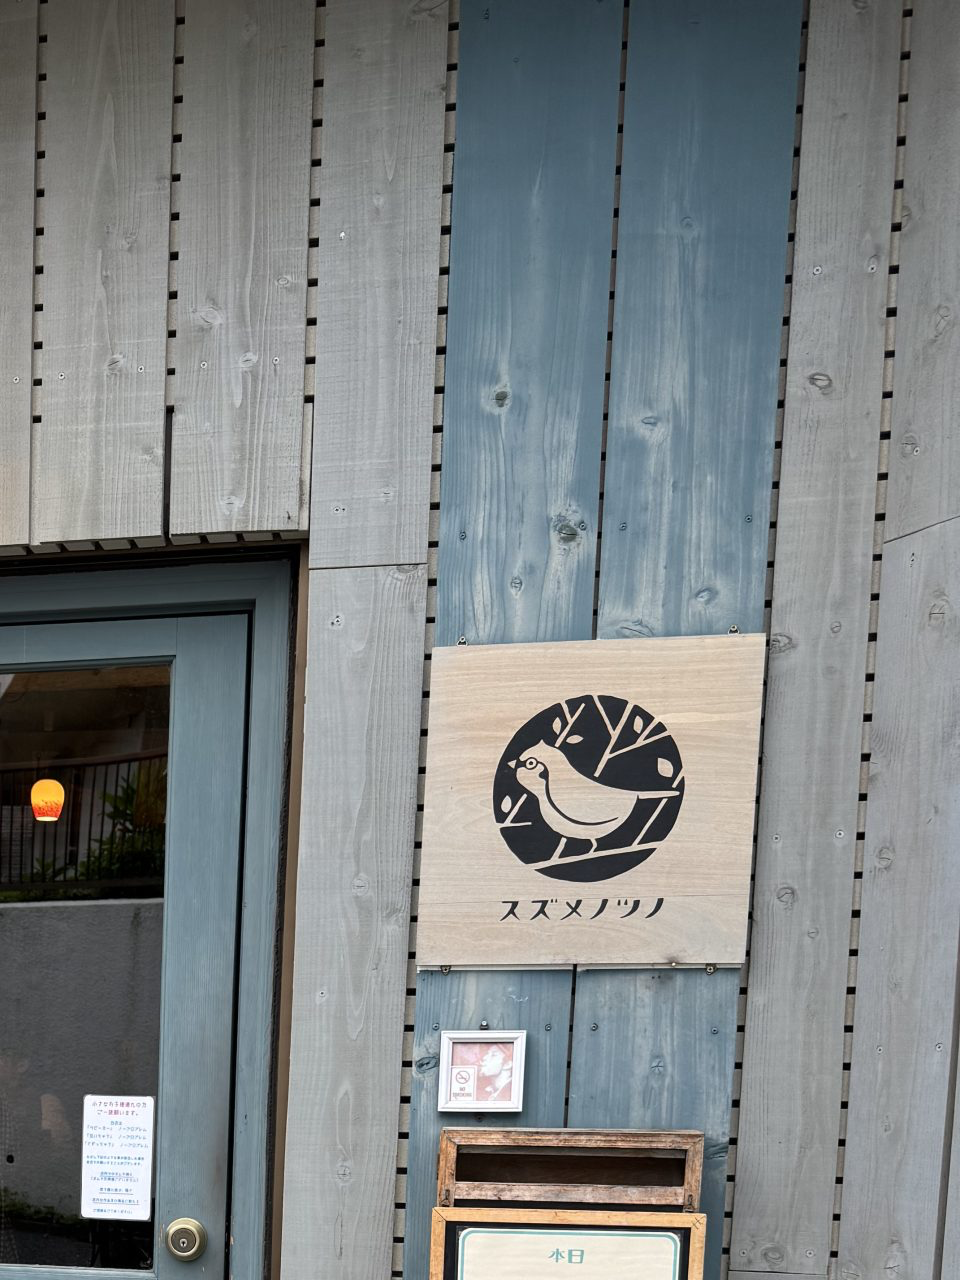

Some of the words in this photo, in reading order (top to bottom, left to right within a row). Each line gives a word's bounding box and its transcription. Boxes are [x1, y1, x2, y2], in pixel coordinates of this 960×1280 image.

[499, 897, 665, 922] スズメノツノ
[547, 1247, 585, 1264] 本日
